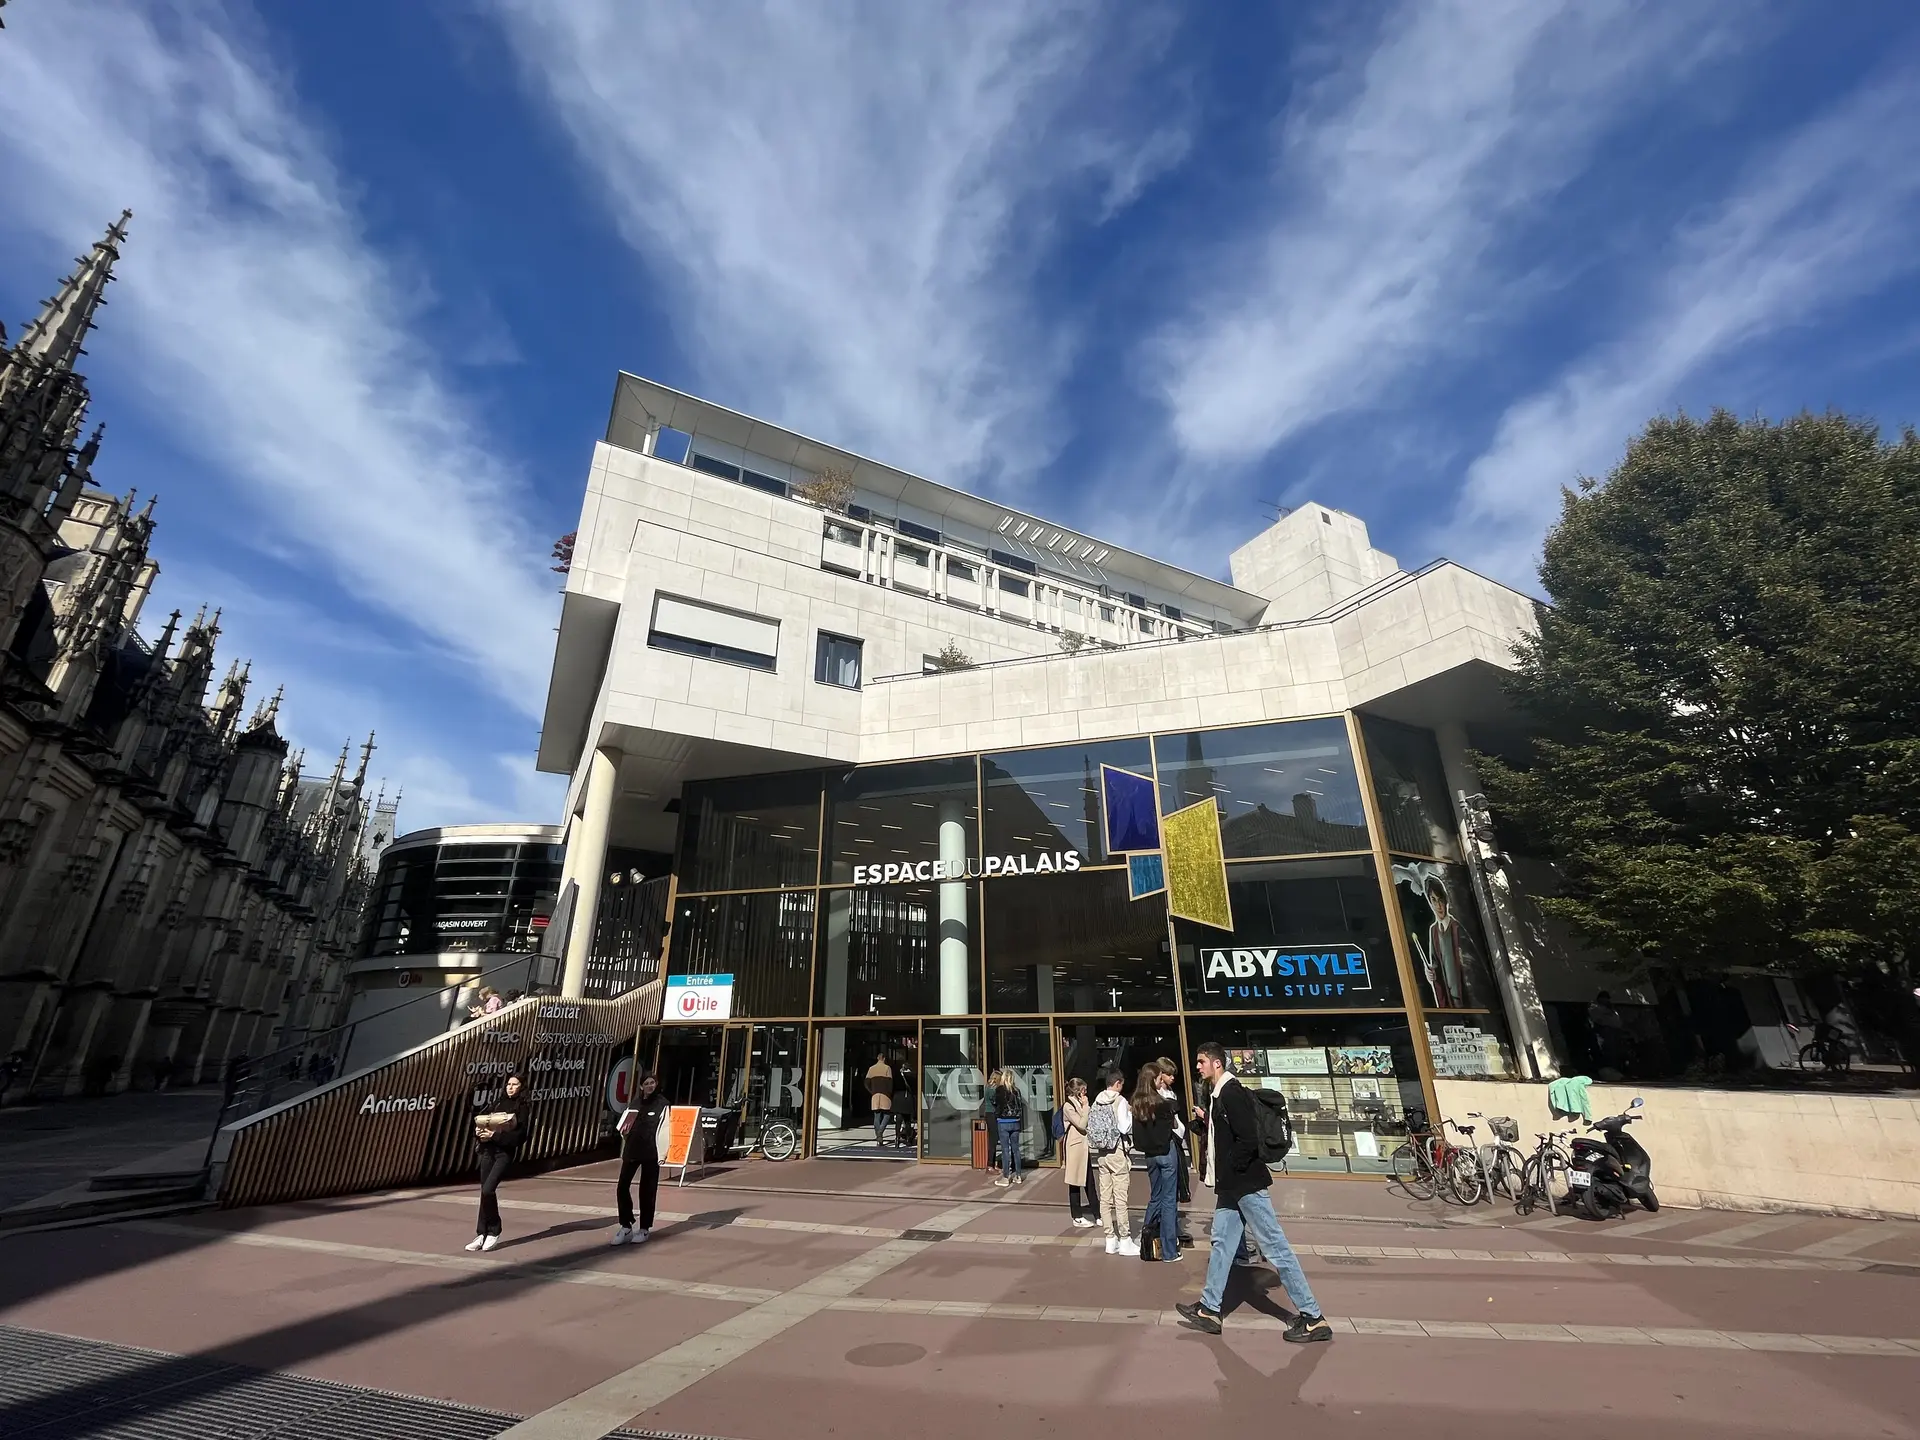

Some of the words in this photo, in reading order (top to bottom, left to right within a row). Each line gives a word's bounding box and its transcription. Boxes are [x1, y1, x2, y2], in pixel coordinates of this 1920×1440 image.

[460, 919, 489, 928] OUVERT
[686, 975, 714, 986] Entrée
[1227, 985, 1274, 998] FULL
[1284, 983, 1346, 997] STUFF
[538, 1003, 581, 1020] habitat
[682, 997, 718, 1012] Utile
[466, 1060, 516, 1077] orange
[528, 1056, 553, 1072] King
[559, 1057, 586, 1072] Jouet
[529, 1085, 592, 1101] ESTAURANTS
[359, 1093, 437, 1115] Animalis
